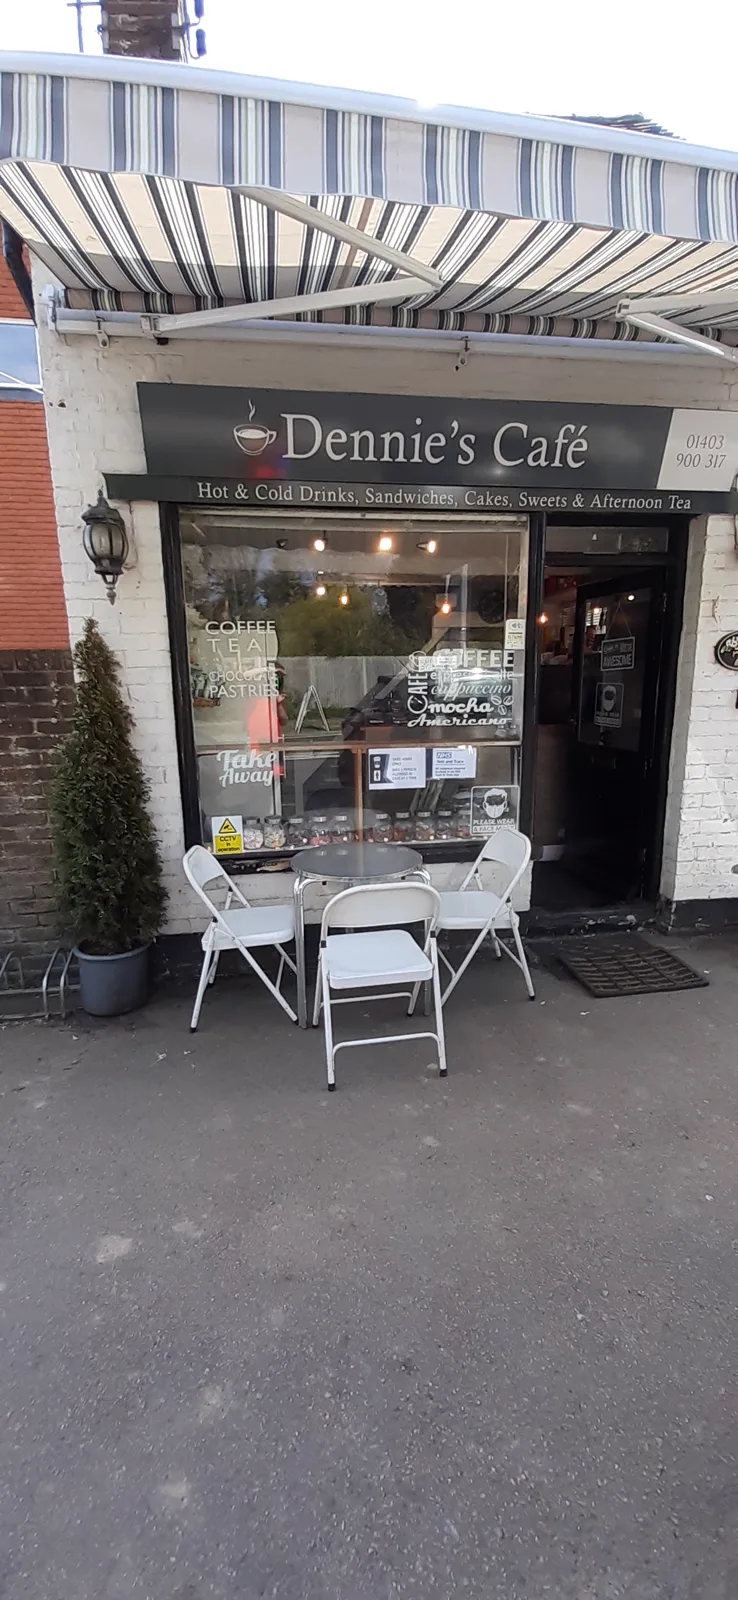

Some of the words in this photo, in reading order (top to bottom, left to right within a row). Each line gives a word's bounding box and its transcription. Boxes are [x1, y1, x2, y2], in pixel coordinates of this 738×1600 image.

[280, 413, 476, 464] Dennie's
[493, 422, 588, 468] Café
[686, 434, 725, 450] 01403
[676, 453, 702, 468] 900
[704, 453, 727, 468] 317
[197, 482, 229, 499] Hot
[234, 483, 249, 500] &
[255, 484, 293, 501] Cold
[299, 486, 359, 505] Drinks,
[365, 487, 459, 507] Sandwiches,
[464, 490, 513, 508] Cakes,
[518, 491, 567, 508] Sweets
[572, 493, 585, 508] &
[590, 493, 663, 509] Afternoon
[668, 495, 691, 510] Tea
[205, 620, 276, 635] COFFEE
[209, 684, 279, 698] PASTRIES
[428, 697, 494, 713] mocha
[407, 713, 513, 727] Americano
[216, 748, 276, 771] Take
[219, 768, 274, 788] Away
